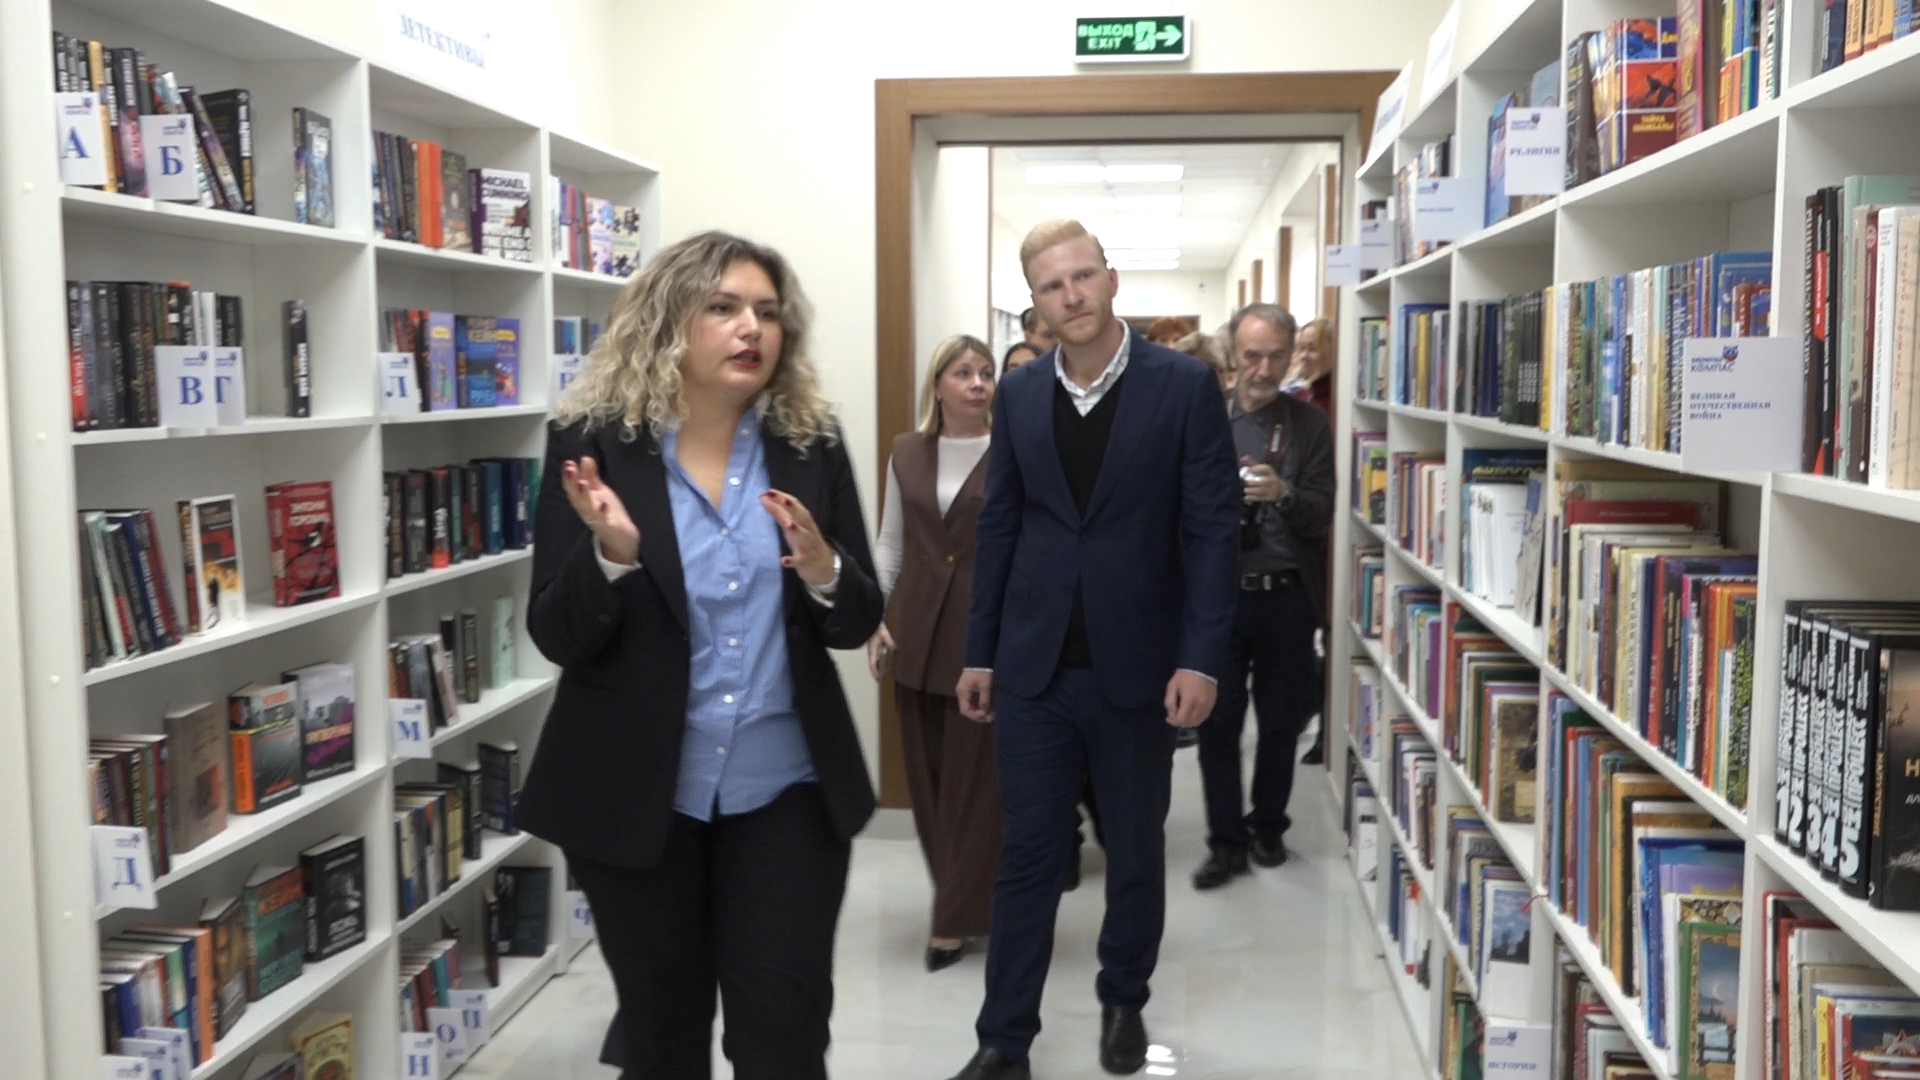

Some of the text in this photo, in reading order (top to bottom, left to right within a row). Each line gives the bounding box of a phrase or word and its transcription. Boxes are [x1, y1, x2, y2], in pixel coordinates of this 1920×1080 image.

[1077, 23, 1134, 38] ВЫХОД
[1088, 37, 1122, 50] EXIT
[62, 126, 90, 159] А
[1510, 147, 1561, 156] РЕЛИГИЯ
[160, 145, 183, 176] Б
[1690, 362, 1736, 373] КОМПАС
[178, 375, 204, 405] В
[215, 375, 232, 404] Г
[385, 375, 408, 398] Л
[1690, 392, 1737, 400] ВЕЛИКАЯ
[1689, 411, 1722, 420] ВОЙНА
[1690, 401, 1772, 410] ОТЕЧЕСТВЕННАЯ
[397, 720, 422, 741] М
[1776, 784, 1790, 836] 1
[1788, 794, 1803, 848] 2
[1806, 803, 1822, 854] 3
[1820, 815, 1838, 867] 4
[1839, 824, 1860, 878] 5
[112, 856, 143, 891] Д
[462, 1009, 483, 1029] П
[435, 1023, 457, 1043] О
[407, 1054, 431, 1077] Н
[1488, 1062, 1538, 1071] ИСТОРИЯ
